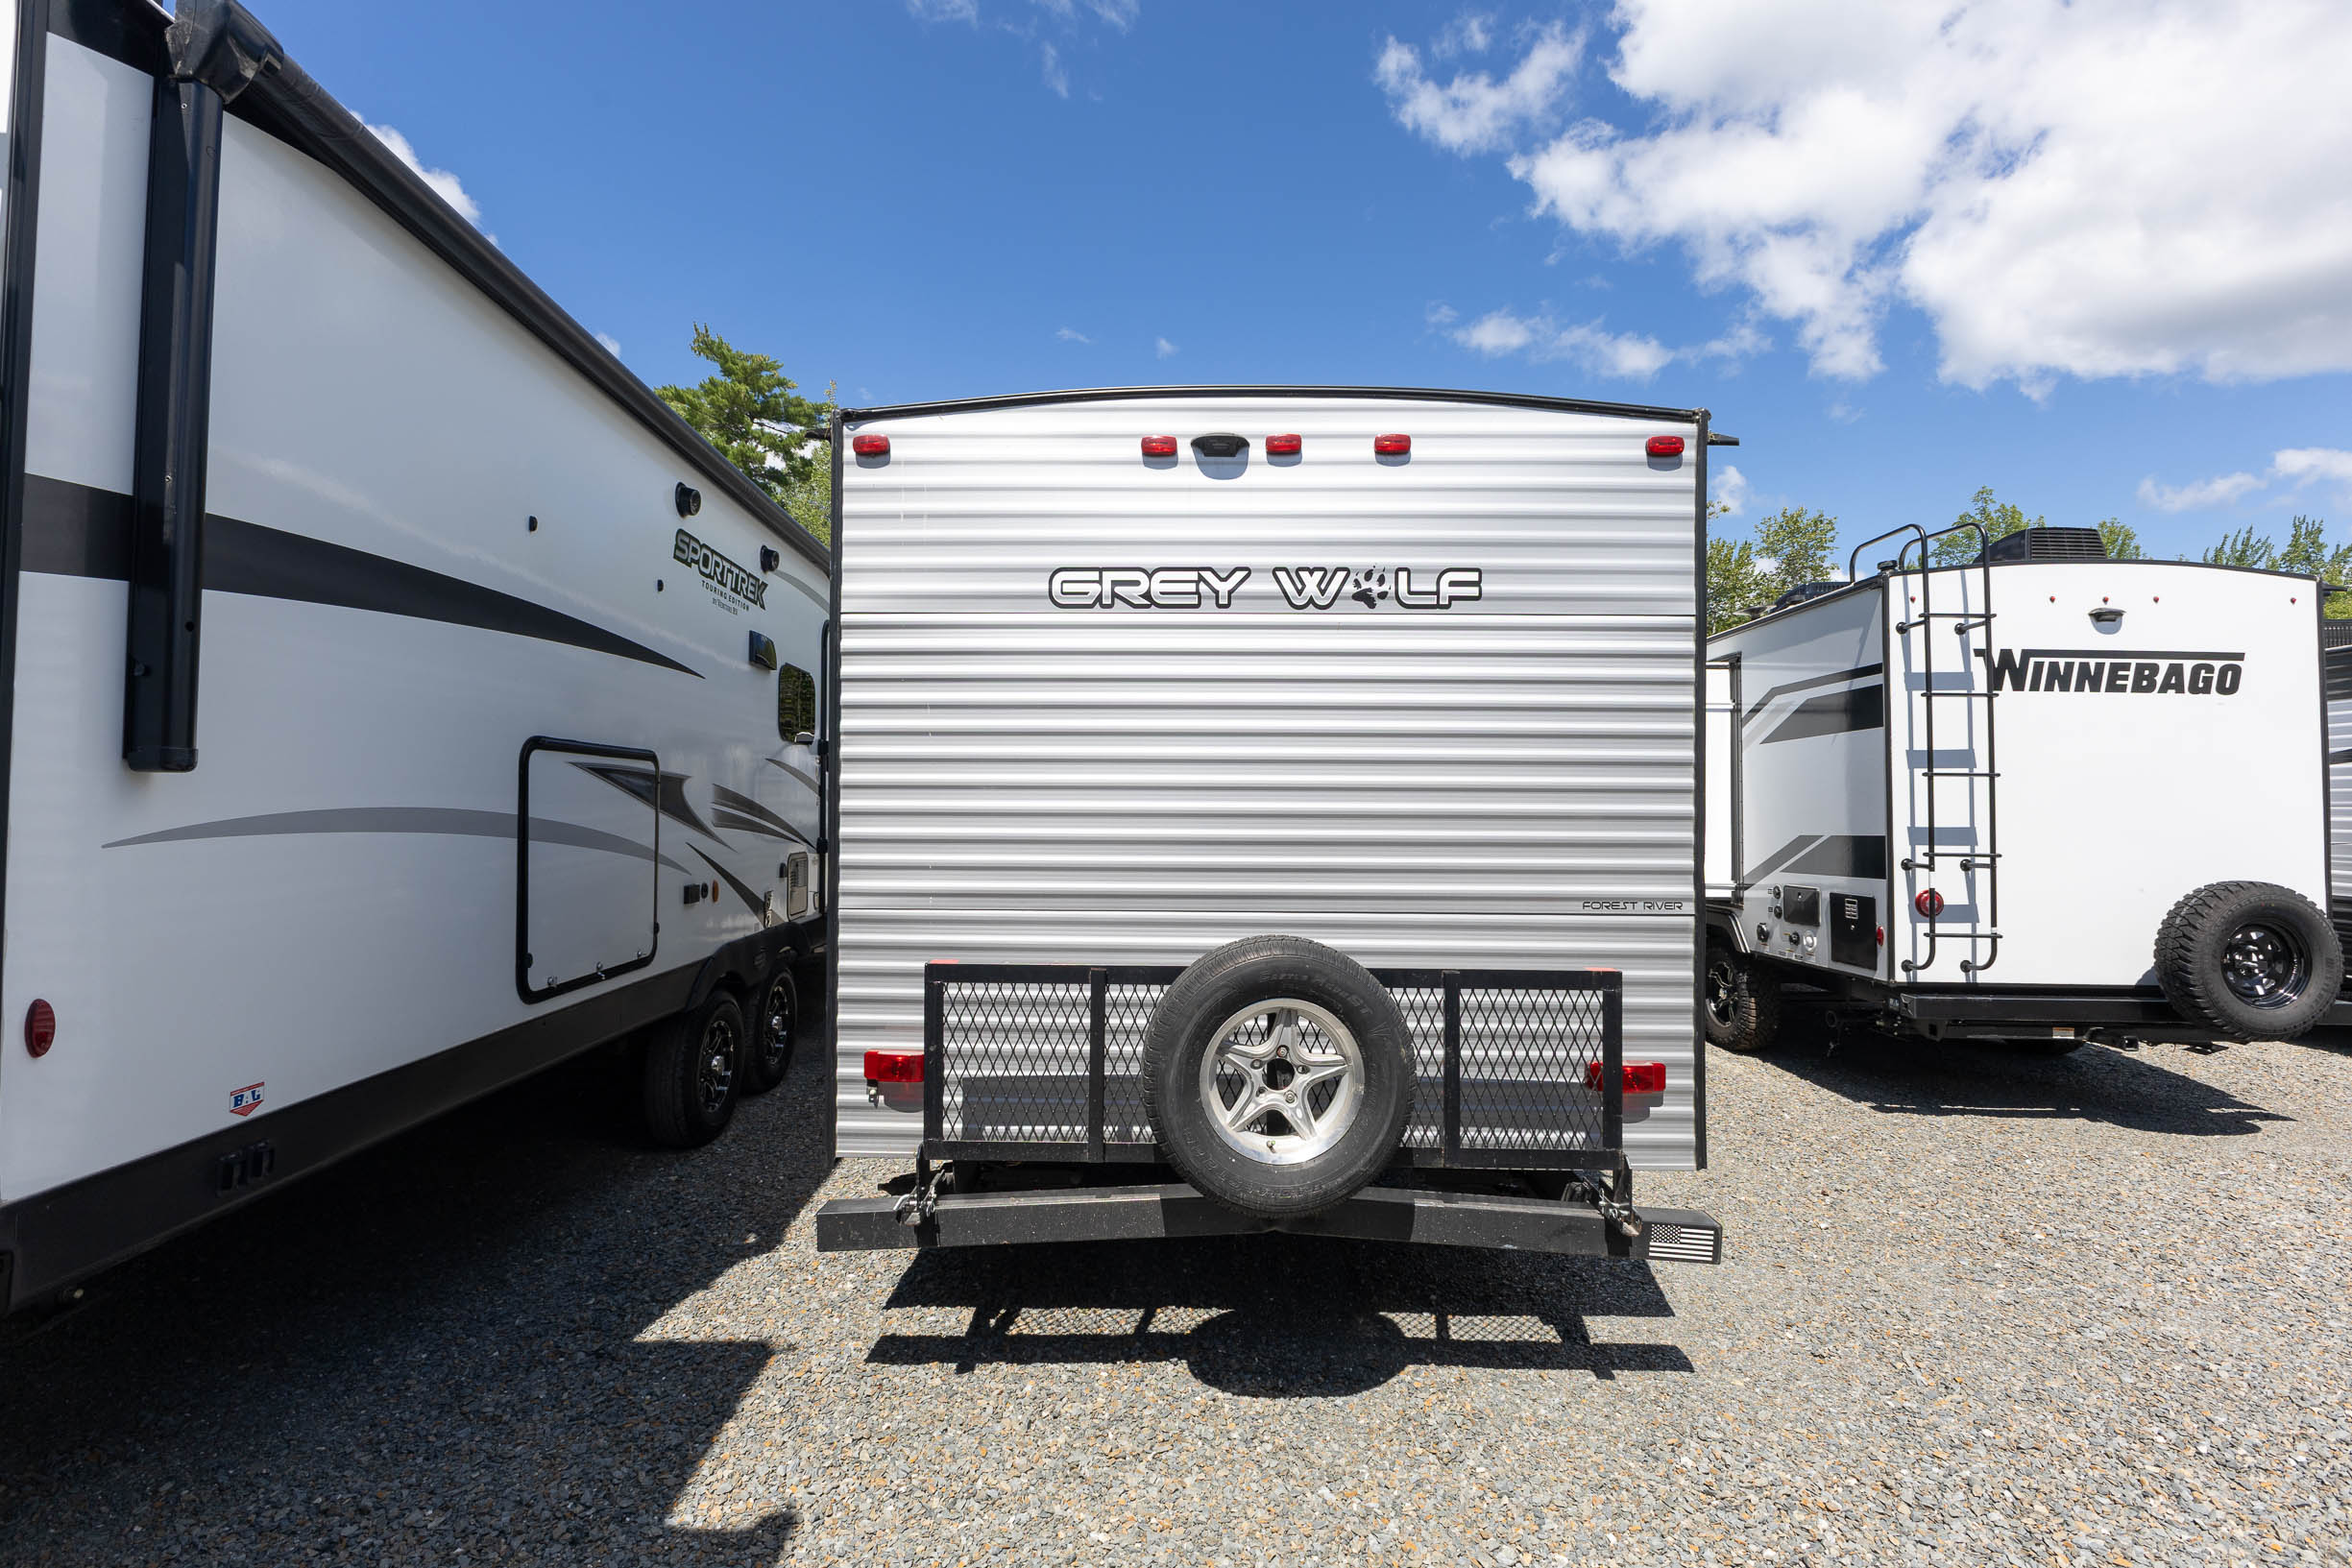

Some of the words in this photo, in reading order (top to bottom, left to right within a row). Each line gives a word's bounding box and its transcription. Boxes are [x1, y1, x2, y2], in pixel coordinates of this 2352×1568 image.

[673, 528, 768, 611] SPORTTREK
[1049, 567, 1250, 609] GREY
[701, 580, 727, 600] TOURING
[728, 594, 749, 612] EDITION
[1974, 648, 2245, 696] WINNEBAGO
[1582, 901, 1637, 910] FOREST
[1643, 901, 1684, 910] RIVER
